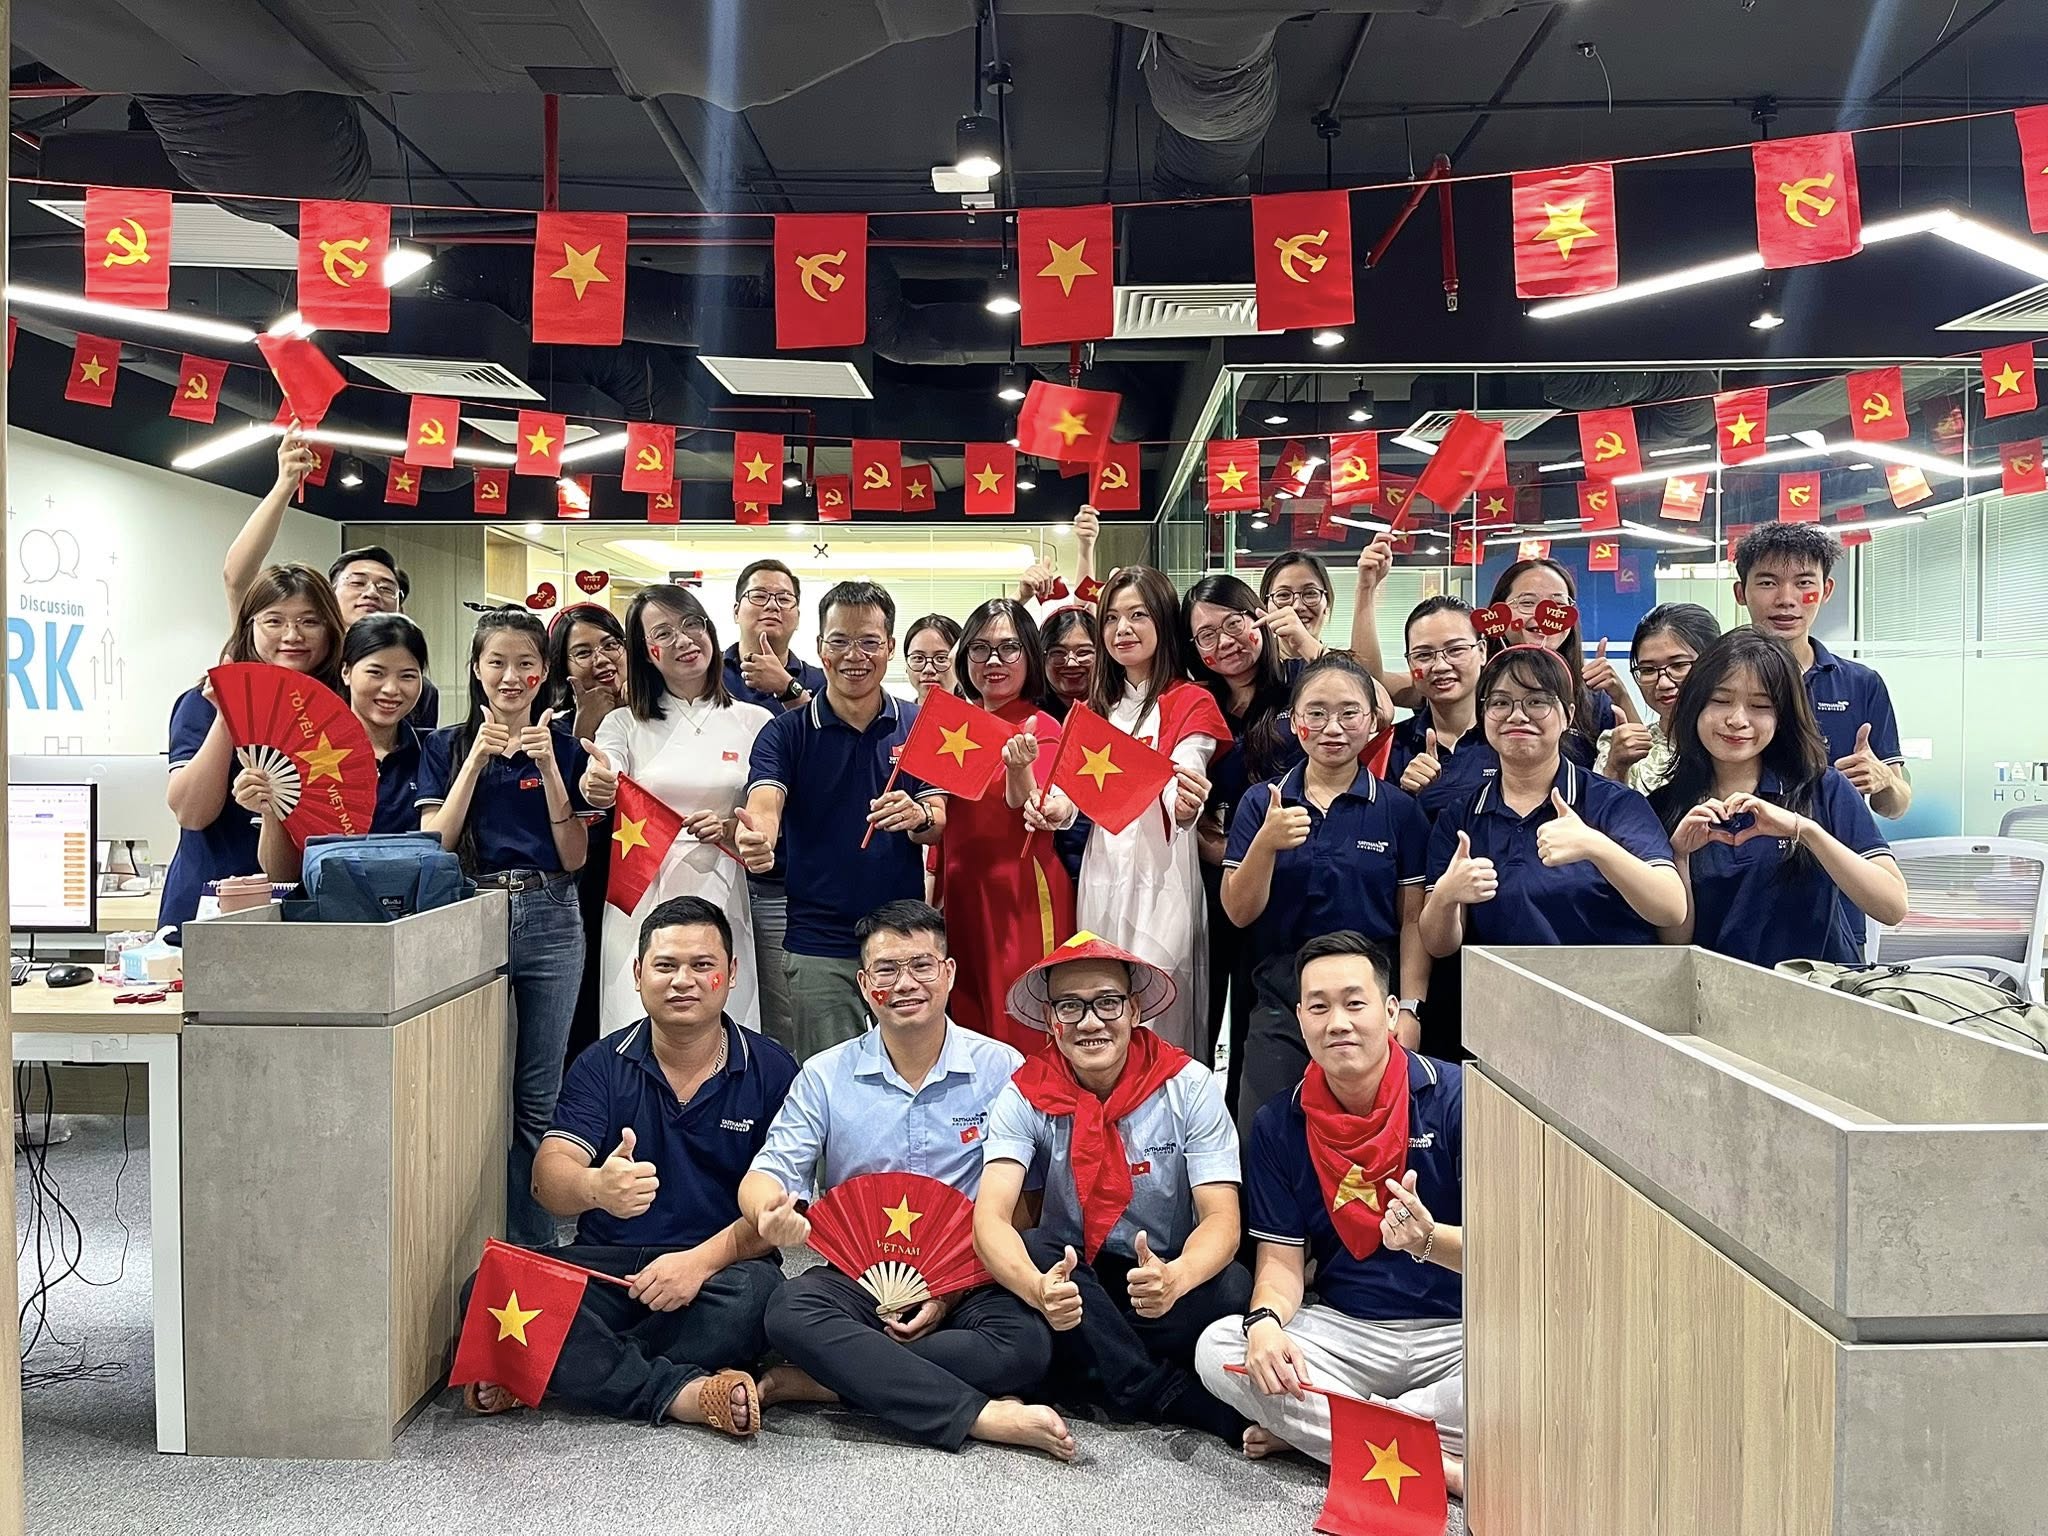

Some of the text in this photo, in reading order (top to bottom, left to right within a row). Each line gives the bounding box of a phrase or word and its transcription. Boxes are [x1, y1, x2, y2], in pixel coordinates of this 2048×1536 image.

[20, 594, 84, 617] Discussion
[1481, 610, 1499, 622] TÔI
[1546, 606, 1568, 619] VIỆT
[1485, 623, 1505, 635] YÊU
[1542, 618, 1564, 631] NAM
[289, 688, 315, 740] TÔI YÊU
[327, 783, 345, 811] VIỆT
[898, 1245, 920, 1256] NAM
